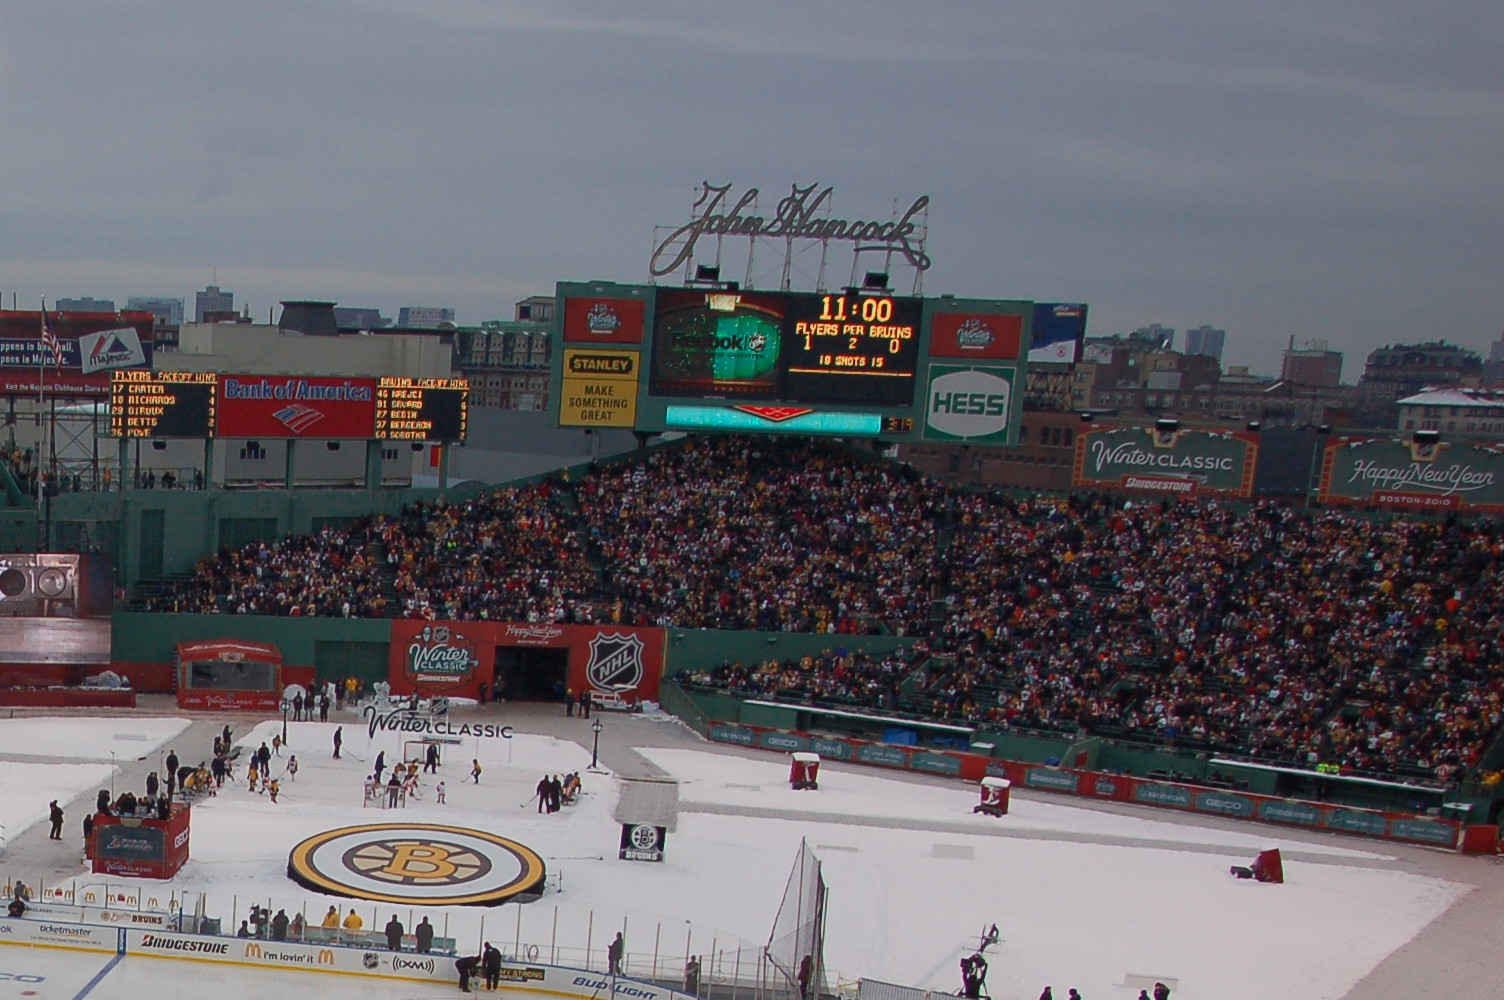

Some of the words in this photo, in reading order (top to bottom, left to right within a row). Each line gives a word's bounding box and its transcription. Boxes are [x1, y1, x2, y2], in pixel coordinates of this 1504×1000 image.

[649, 181, 760, 276] John
[761, 183, 931, 270] Hancock
[820, 297, 892, 321] 11:00
[796, 322, 838, 336] FLYERS
[843, 324, 865, 336] PER
[869, 325, 912, 338] BRUINS
[672, 333, 743, 350] Reebok
[803, 333, 811, 350] 1
[849, 337, 857, 350] 2
[889, 338, 899, 354] 0
[573, 358, 629, 371] STANLEY
[835, 356, 866, 368] SHOTS
[871, 356, 883, 368] 15
[115, 371, 151, 381] FLYERS
[113, 384, 124, 394] 17
[225, 378, 274, 399] Bank
[275, 380, 295, 399] of
[296, 380, 372, 401] America
[584, 384, 614, 397] MAKE
[568, 398, 628, 410] SOMETHING
[933, 392, 1005, 417] HESS
[580, 410, 613, 422] GREAT
[1092, 440, 1156, 472] Winter
[1157, 454, 1233, 470] CLASSIC
[1125, 477, 1193, 492] BRIDGESTONE
[1348, 459, 1412, 491] Happy
[1408, 462, 1448, 483] New
[1441, 464, 1494, 496] Year
[409, 643, 470, 672] Winter
[599, 649, 632, 681] NHL
[420, 660, 467, 671] CLASSIC
[363, 705, 433, 740] Winter
[434, 722, 514, 739] CLASSIC
[768, 737, 797, 748] GEICO
[1148, 792, 1185, 803] HONDA
[1205, 798, 1242, 810] GEICO
[132, 914, 163, 925] BRUINS
[40, 924, 92, 937] ticketmaster
[141, 934, 229, 954] BRIDGESTONE
[264, 951, 278, 960] i'm
[280, 951, 306, 962] lovin'
[307, 954, 314, 963] it
[573, 977, 607, 990] BUD
[614, 981, 657, 1000] LIGHT
